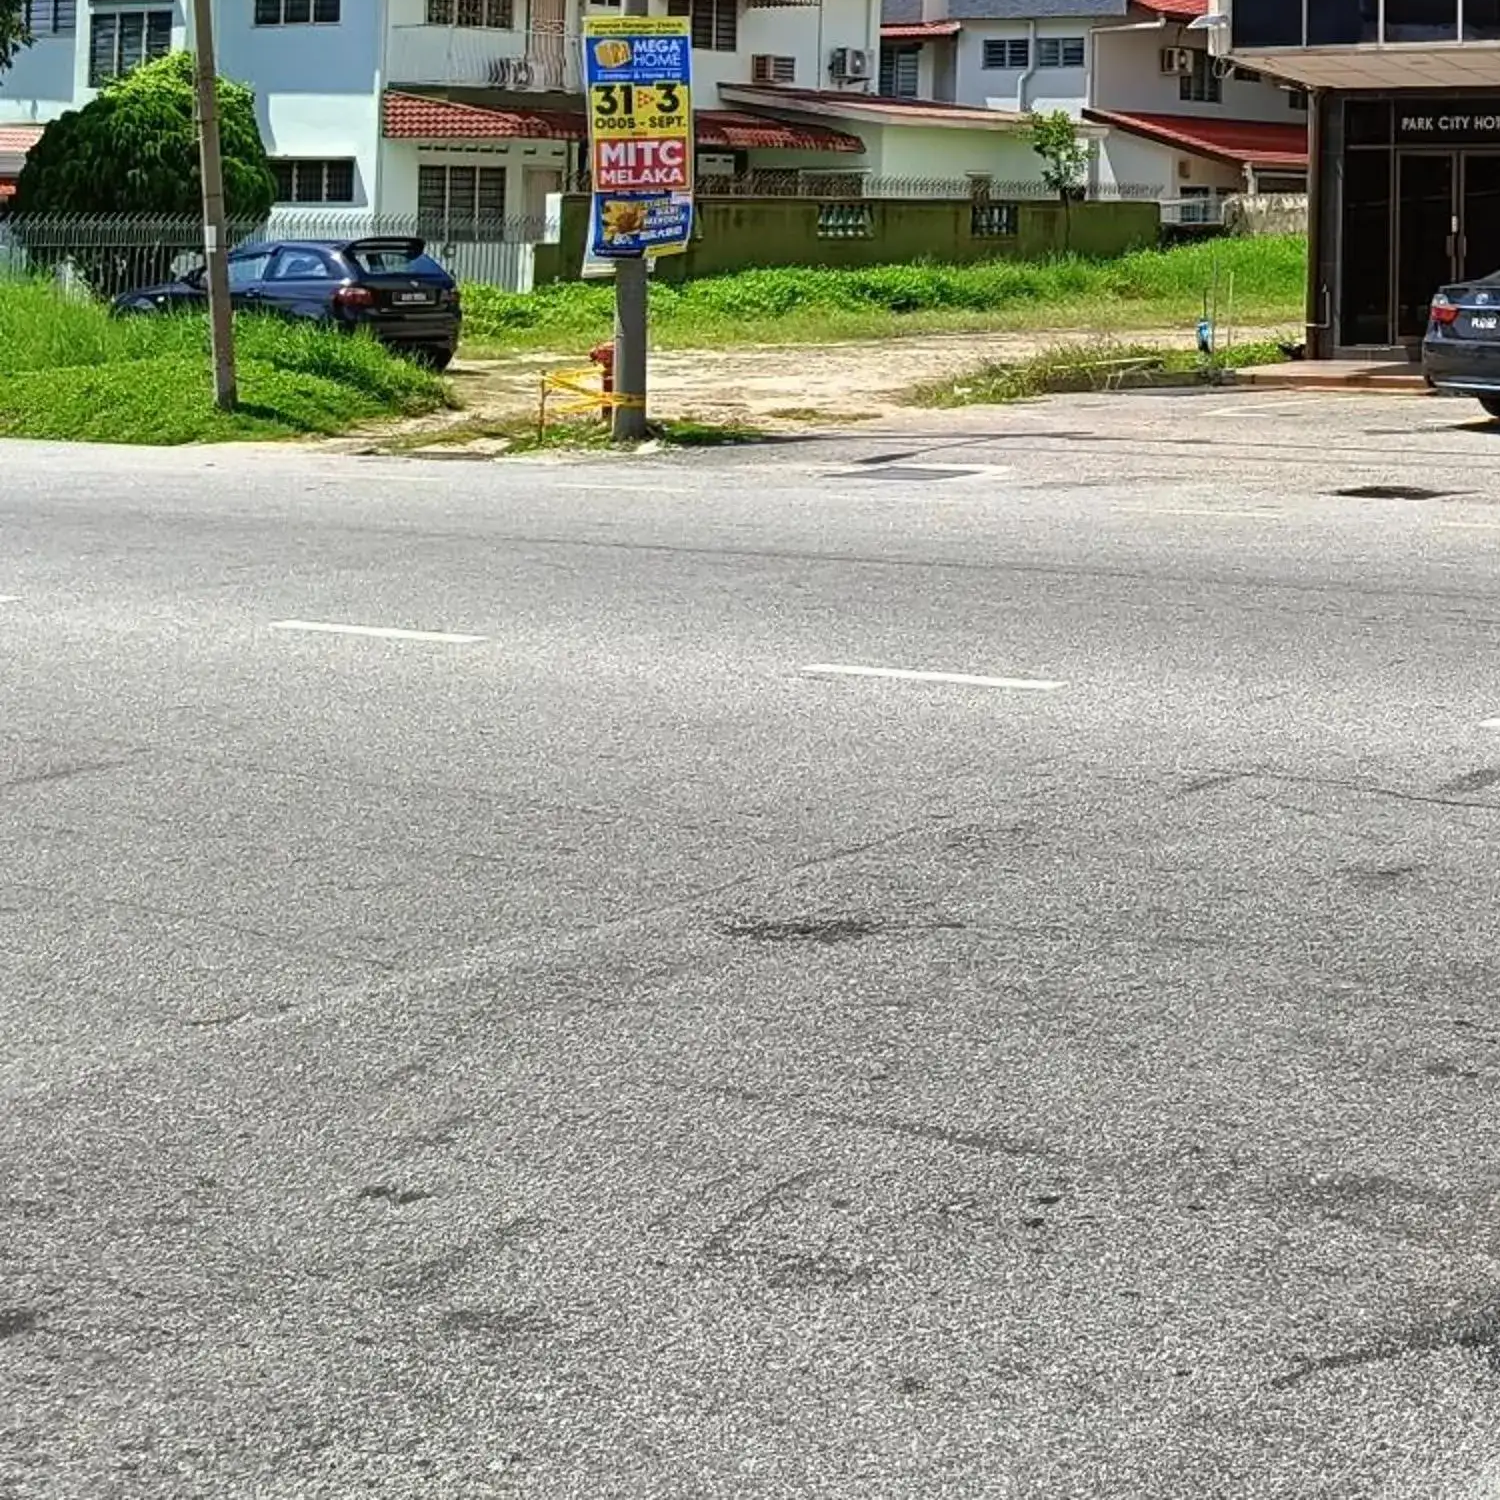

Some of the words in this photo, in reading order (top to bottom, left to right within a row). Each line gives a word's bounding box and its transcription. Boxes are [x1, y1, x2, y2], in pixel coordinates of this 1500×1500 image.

[633, 39, 681, 53] MEGA
[633, 53, 681, 67] HOME
[595, 84, 633, 115] 31
[655, 83, 680, 113] 3
[1401, 117, 1434, 131] PARK
[1437, 116, 1471, 130] CITY
[599, 140, 683, 167] MITC
[599, 167, 685, 185] MELAKA
